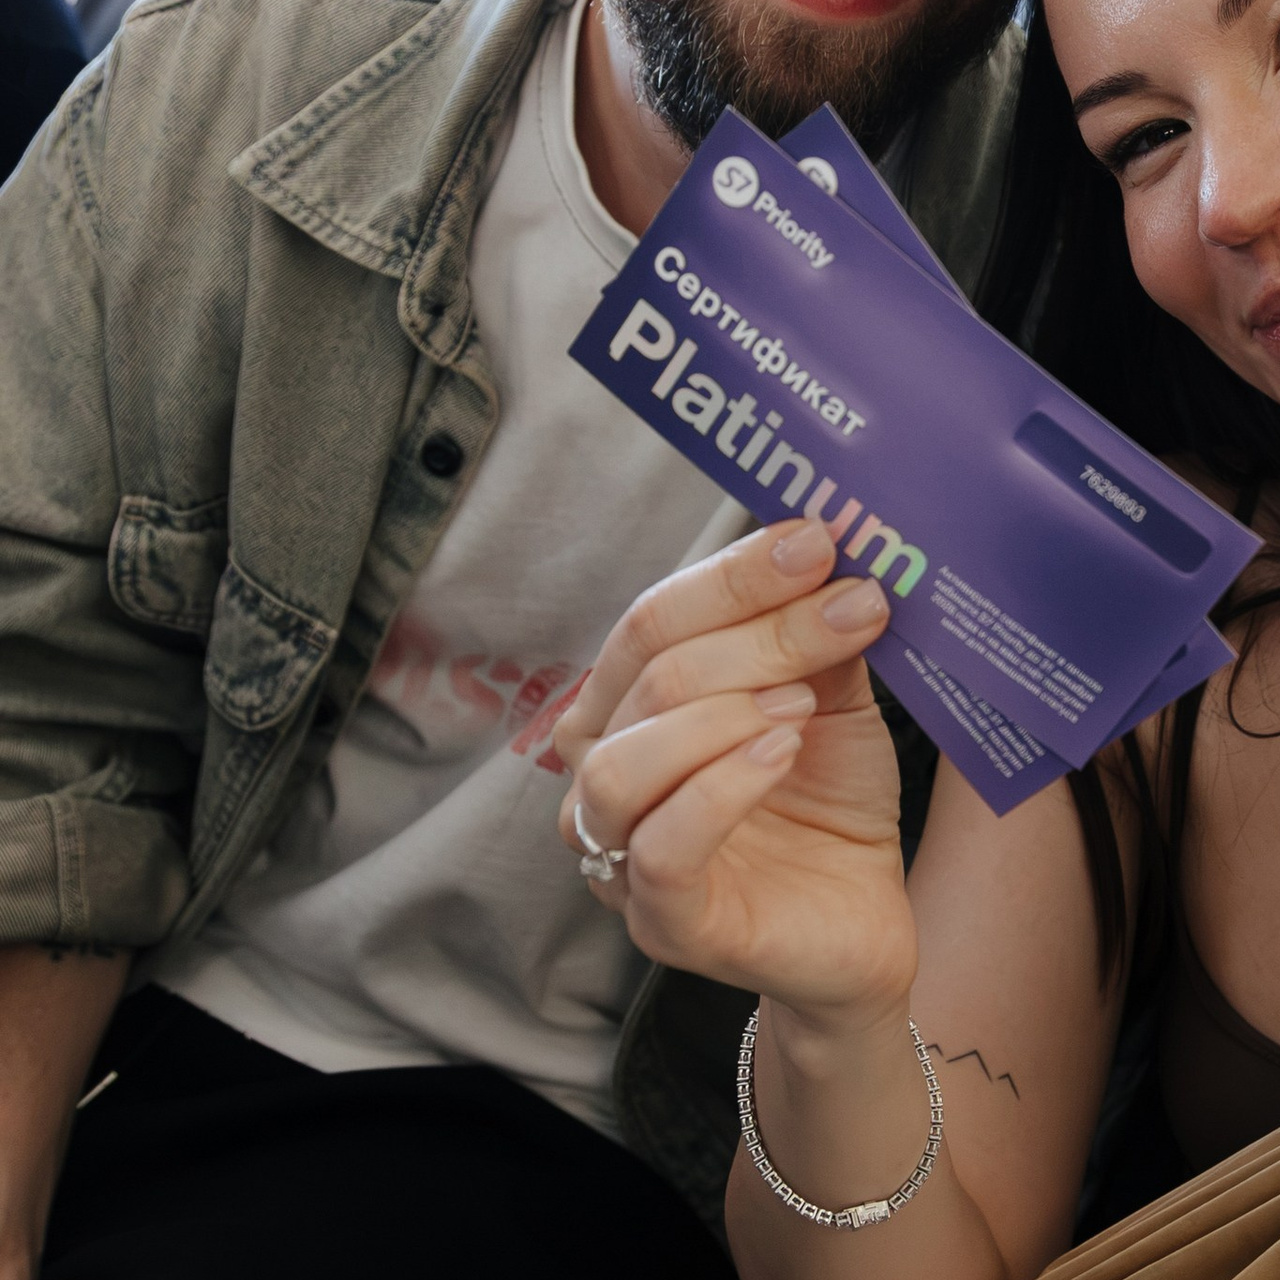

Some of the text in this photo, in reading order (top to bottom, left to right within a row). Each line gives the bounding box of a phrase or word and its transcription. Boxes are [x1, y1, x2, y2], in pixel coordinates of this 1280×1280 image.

[753, 190, 835, 269] Priority
[654, 246, 867, 436] Сертификат
[609, 298, 929, 598] Platinum
